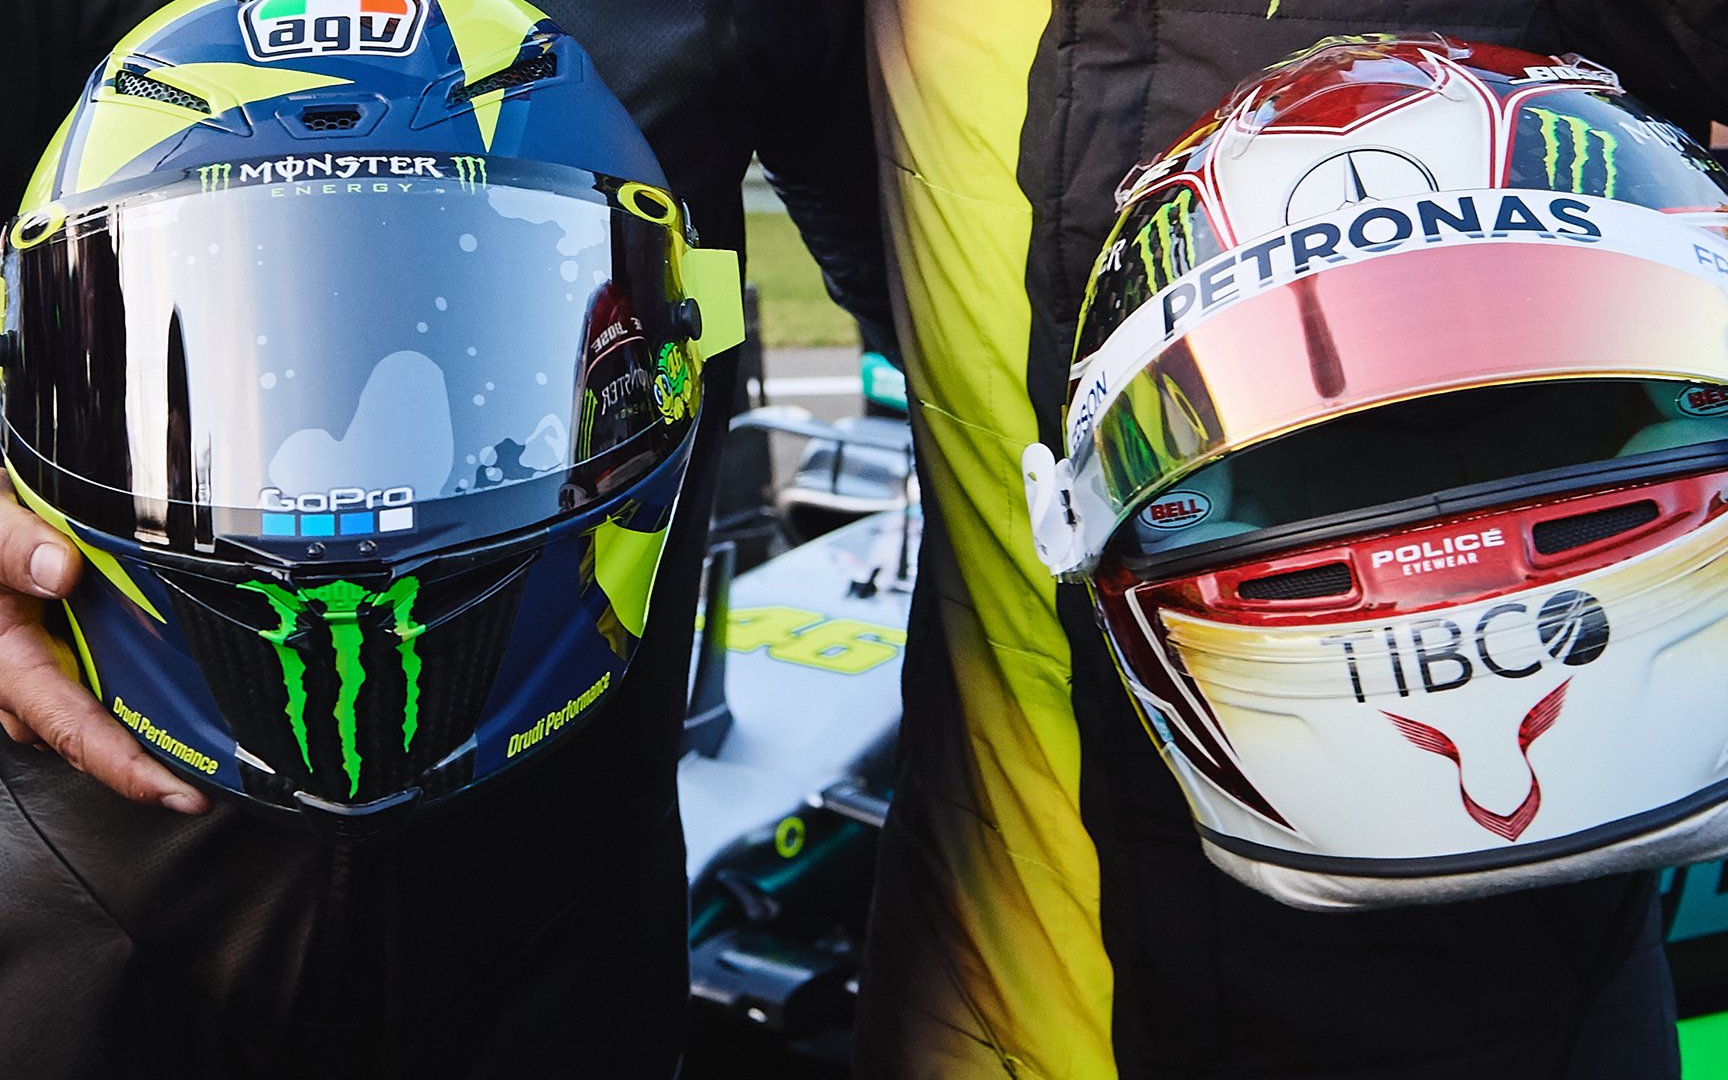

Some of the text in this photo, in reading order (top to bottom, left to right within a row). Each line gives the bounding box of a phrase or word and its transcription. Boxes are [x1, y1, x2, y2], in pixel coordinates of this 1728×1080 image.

[239, 153, 444, 184] MONSTER
[271, 182, 413, 198] ENERGY
[1164, 195, 1603, 341] PETRONAS
[258, 486, 414, 513] GoPro
[1150, 499, 1204, 521] BELL
[1402, 552, 1479, 576] EYEWEAR
[714, 606, 908, 675] 46
[113, 696, 219, 775] Drudi Performance
[507, 718, 545, 758] Drudi
